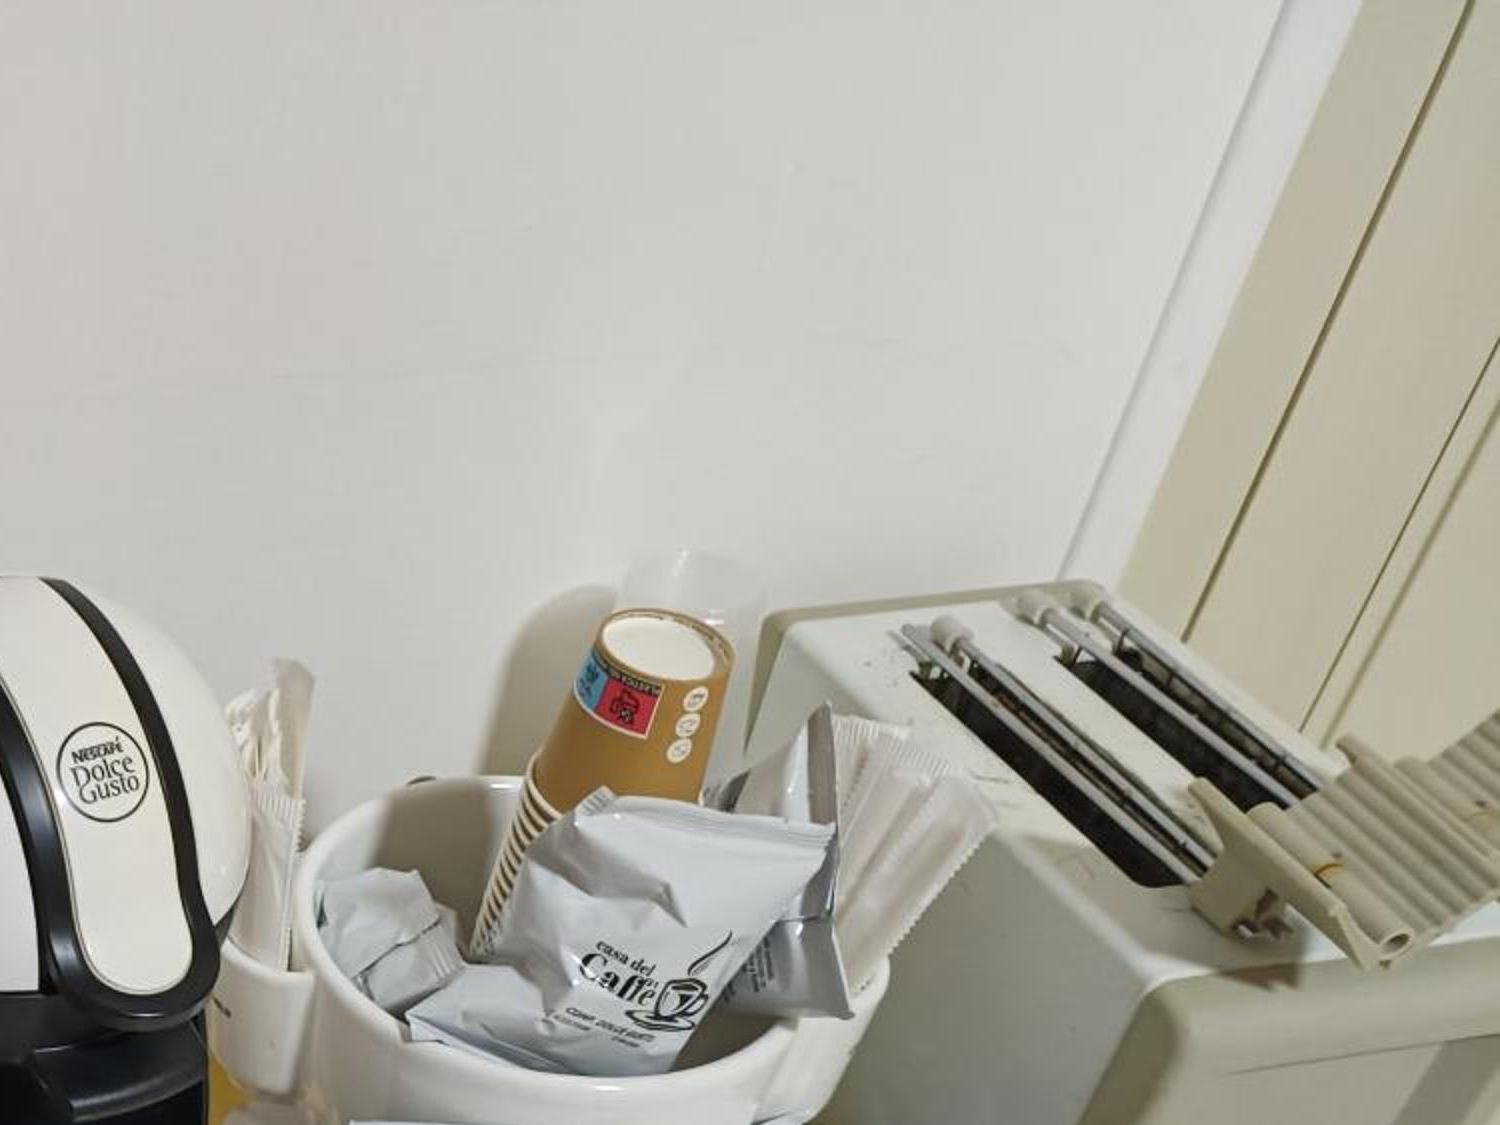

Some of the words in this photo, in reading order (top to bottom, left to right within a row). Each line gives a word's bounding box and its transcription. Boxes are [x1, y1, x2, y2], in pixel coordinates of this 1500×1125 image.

[71, 736, 124, 764] NESCAFÉ
[70, 757, 136, 787] Dolce
[79, 773, 140, 804] Gusto
[596, 941, 629, 965] casa
[630, 959, 656, 977] del
